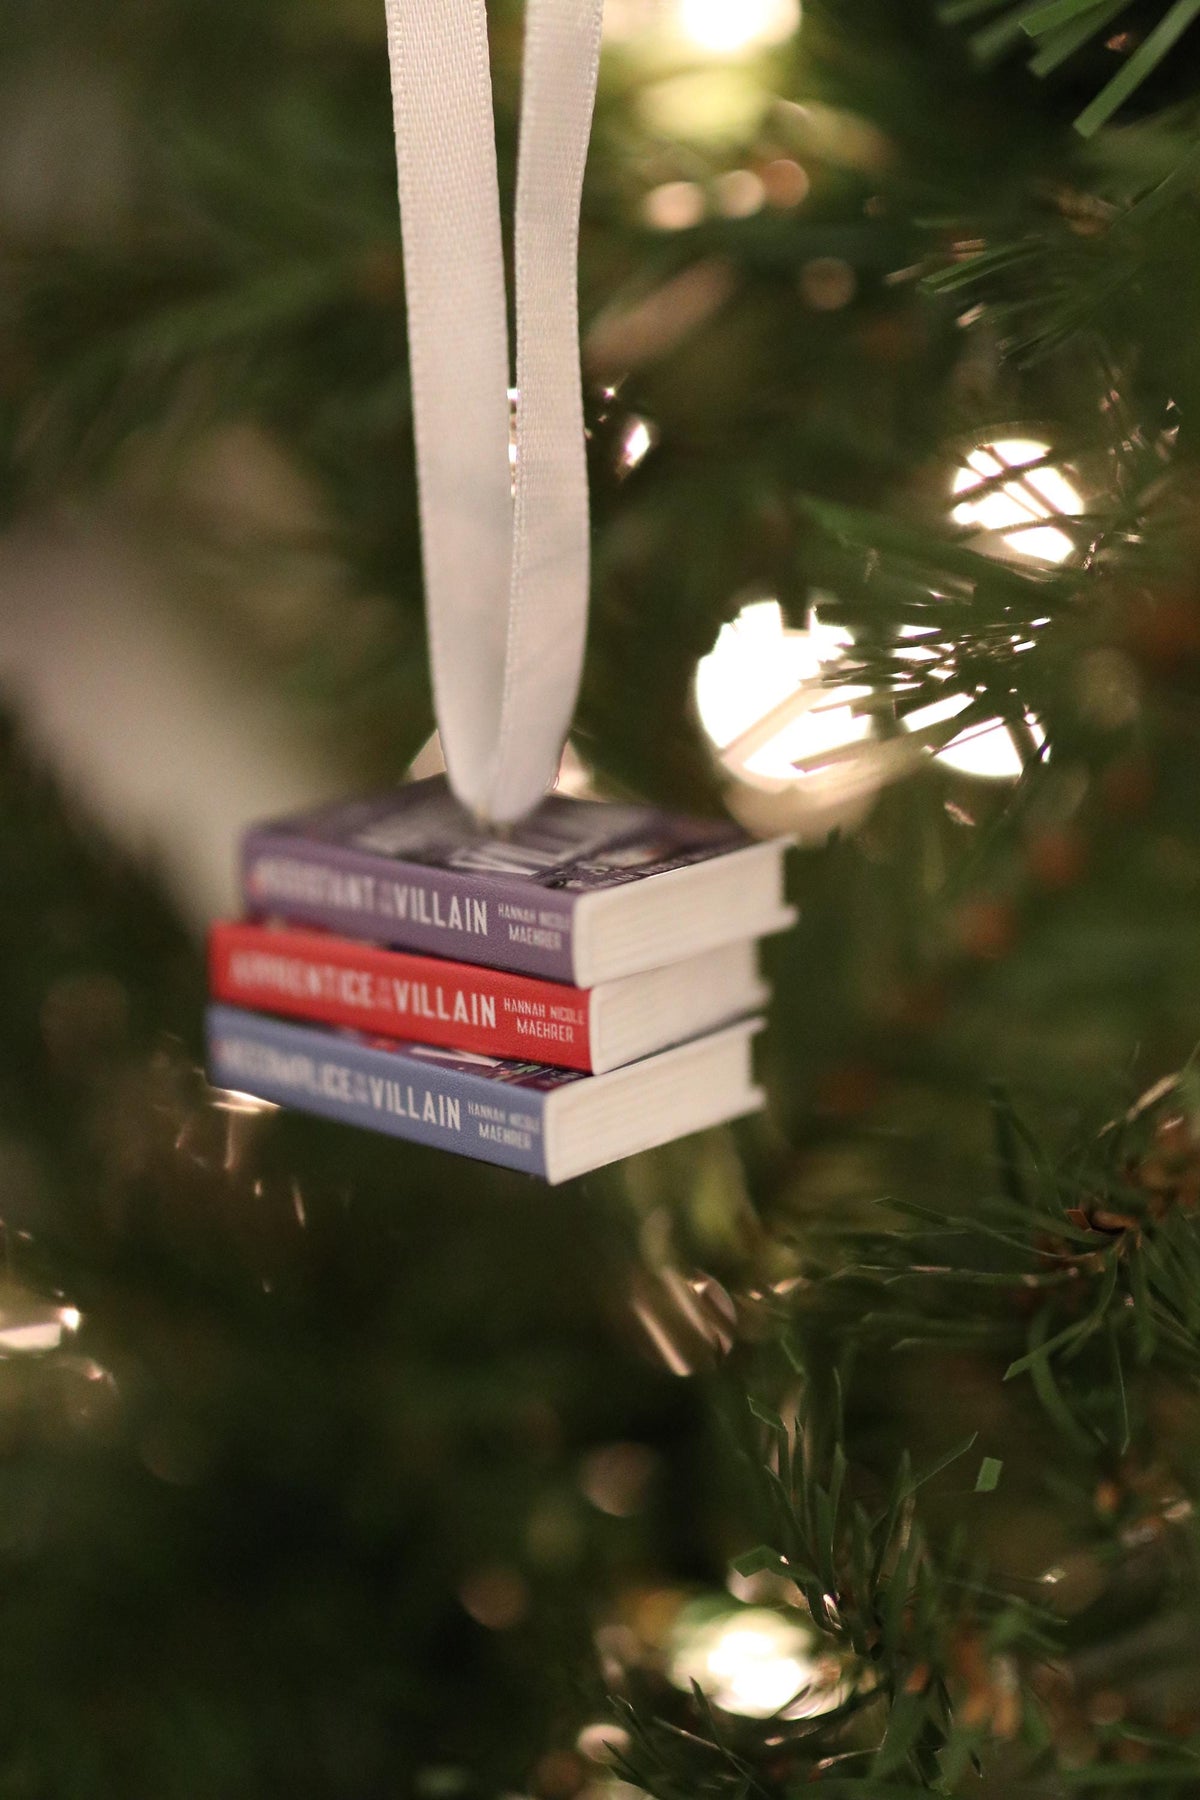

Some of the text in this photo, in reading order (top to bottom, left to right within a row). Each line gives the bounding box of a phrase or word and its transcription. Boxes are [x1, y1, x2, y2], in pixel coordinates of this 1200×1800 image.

[394, 884, 488, 936] VILLAIN
[393, 979, 496, 1028] VILLAIN
[503, 998, 585, 1026] HANNAH NICOLE
[516, 1018, 574, 1043] MAEHRER
[369, 1075, 460, 1131] VILLAIN
